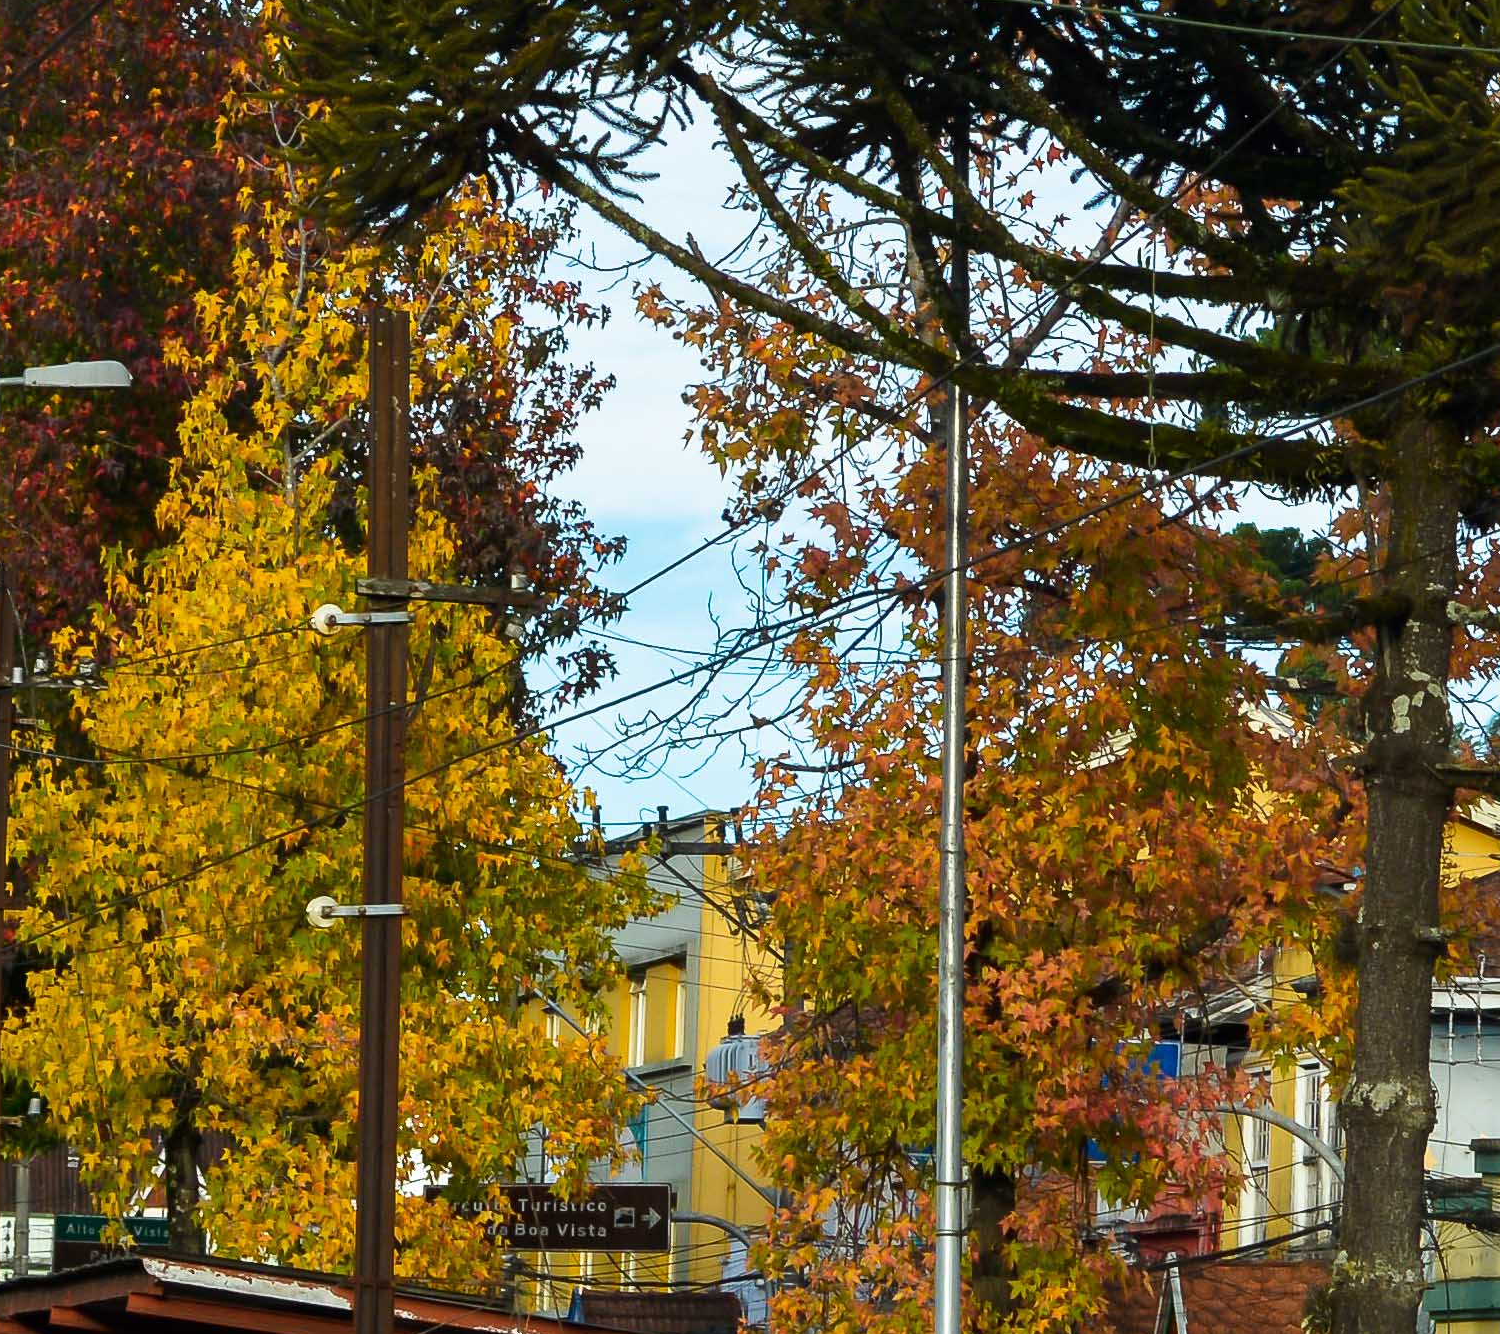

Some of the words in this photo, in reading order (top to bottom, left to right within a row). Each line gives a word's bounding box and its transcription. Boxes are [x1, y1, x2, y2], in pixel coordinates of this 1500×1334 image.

[518, 1198, 607, 1213] Turístico
[66, 1223, 96, 1235] Alto
[133, 1225, 170, 1238] Vista
[514, 1223, 549, 1237] Boa
[557, 1223, 607, 1238] Vista
